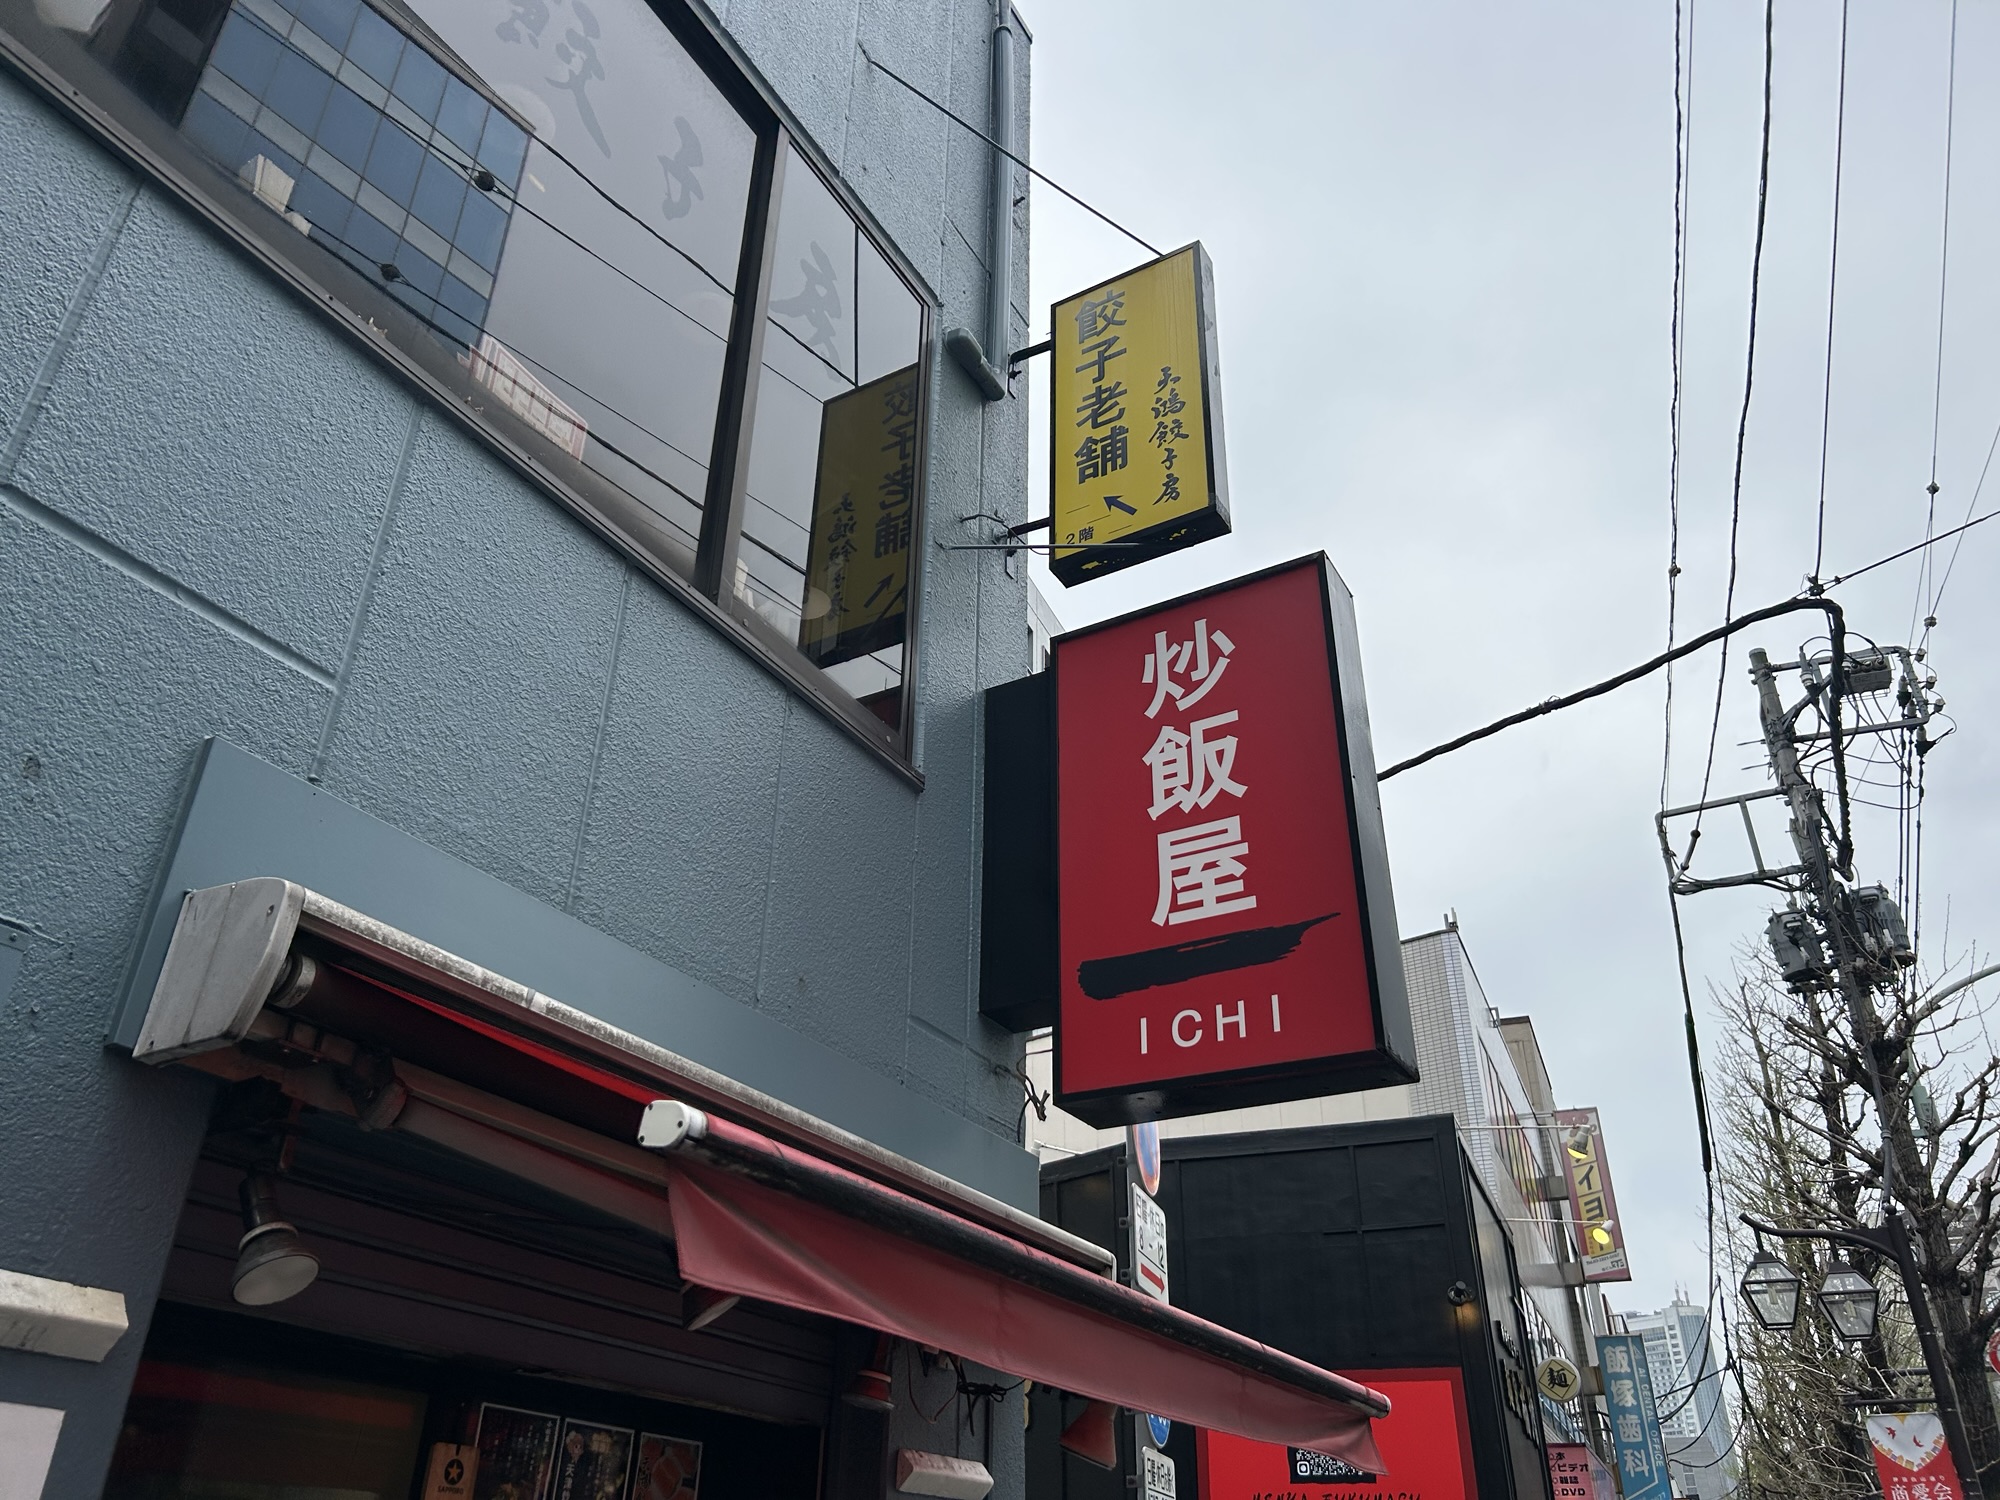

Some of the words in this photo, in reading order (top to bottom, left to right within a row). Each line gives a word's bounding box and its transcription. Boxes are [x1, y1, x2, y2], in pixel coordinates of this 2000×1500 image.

[1074, 289, 1129, 484] 餃子老舗
[1066, 526, 1094, 546] 2階
[1141, 618, 1257, 927] 炒飯屋
[1140, 994, 1281, 1054] ICHI
[1603, 1345, 1649, 1478] 飯塚歯科
[1650, 1430, 1664, 1467] OFFICE
[1558, 1463, 1589, 1472] ビデオ
[1559, 1475, 1579, 1485] 雑誌
[1562, 1488, 1586, 1496] DVD
